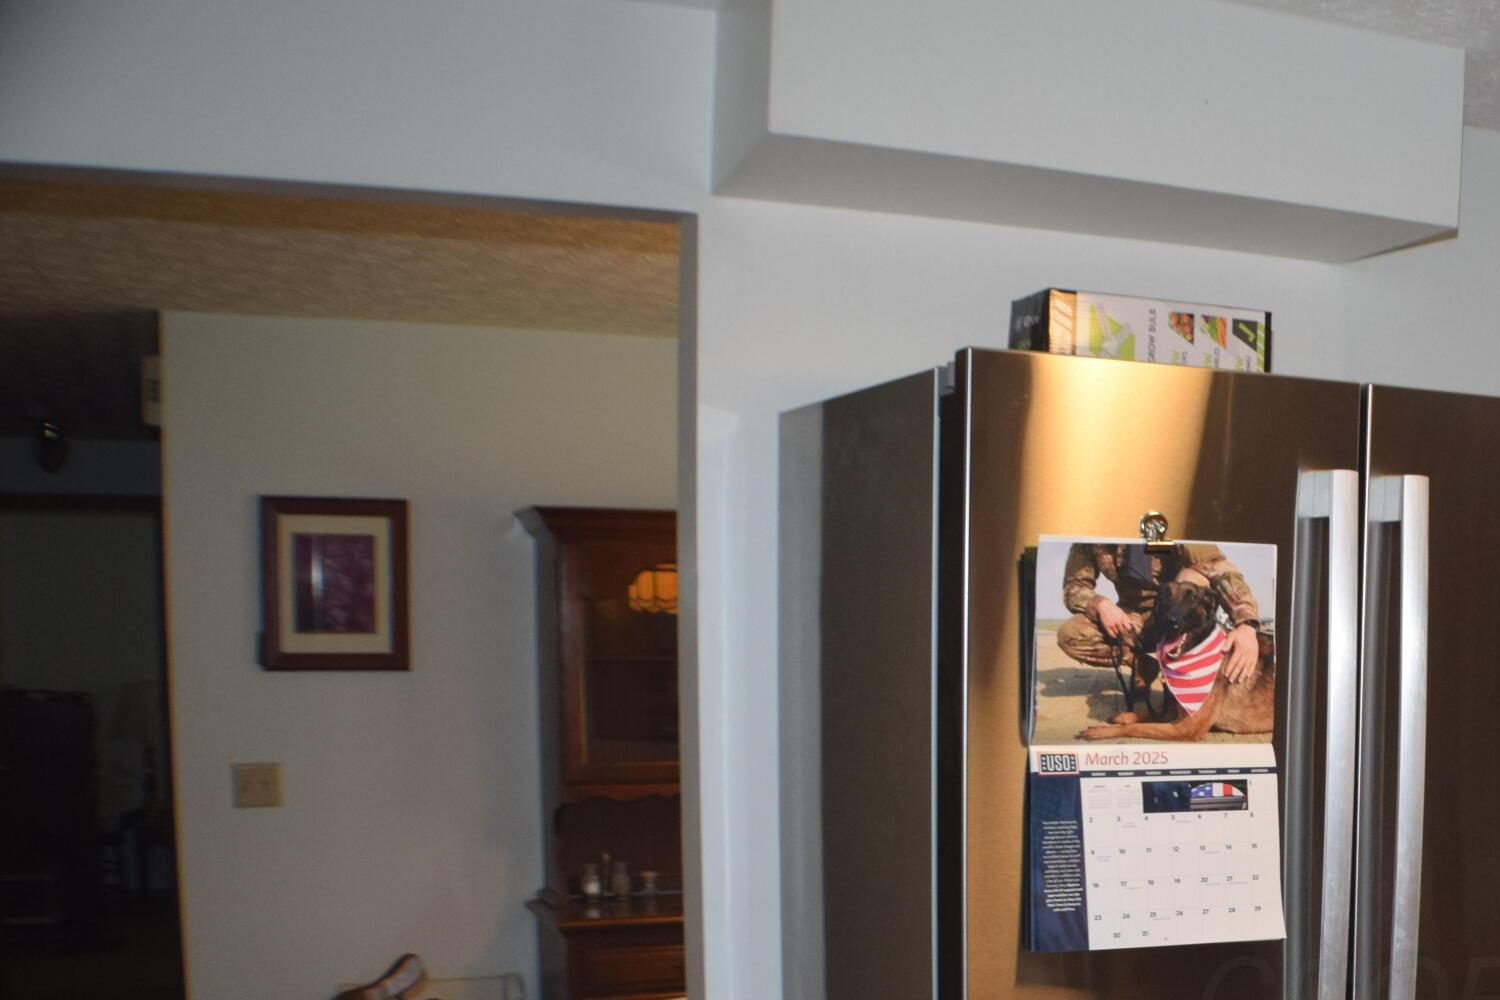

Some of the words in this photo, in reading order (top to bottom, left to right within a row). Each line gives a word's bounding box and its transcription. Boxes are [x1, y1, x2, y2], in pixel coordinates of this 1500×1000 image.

[1048, 755, 1069, 772] USO
[1085, 751, 1129, 766] March
[1132, 751, 1169, 765] 2025
